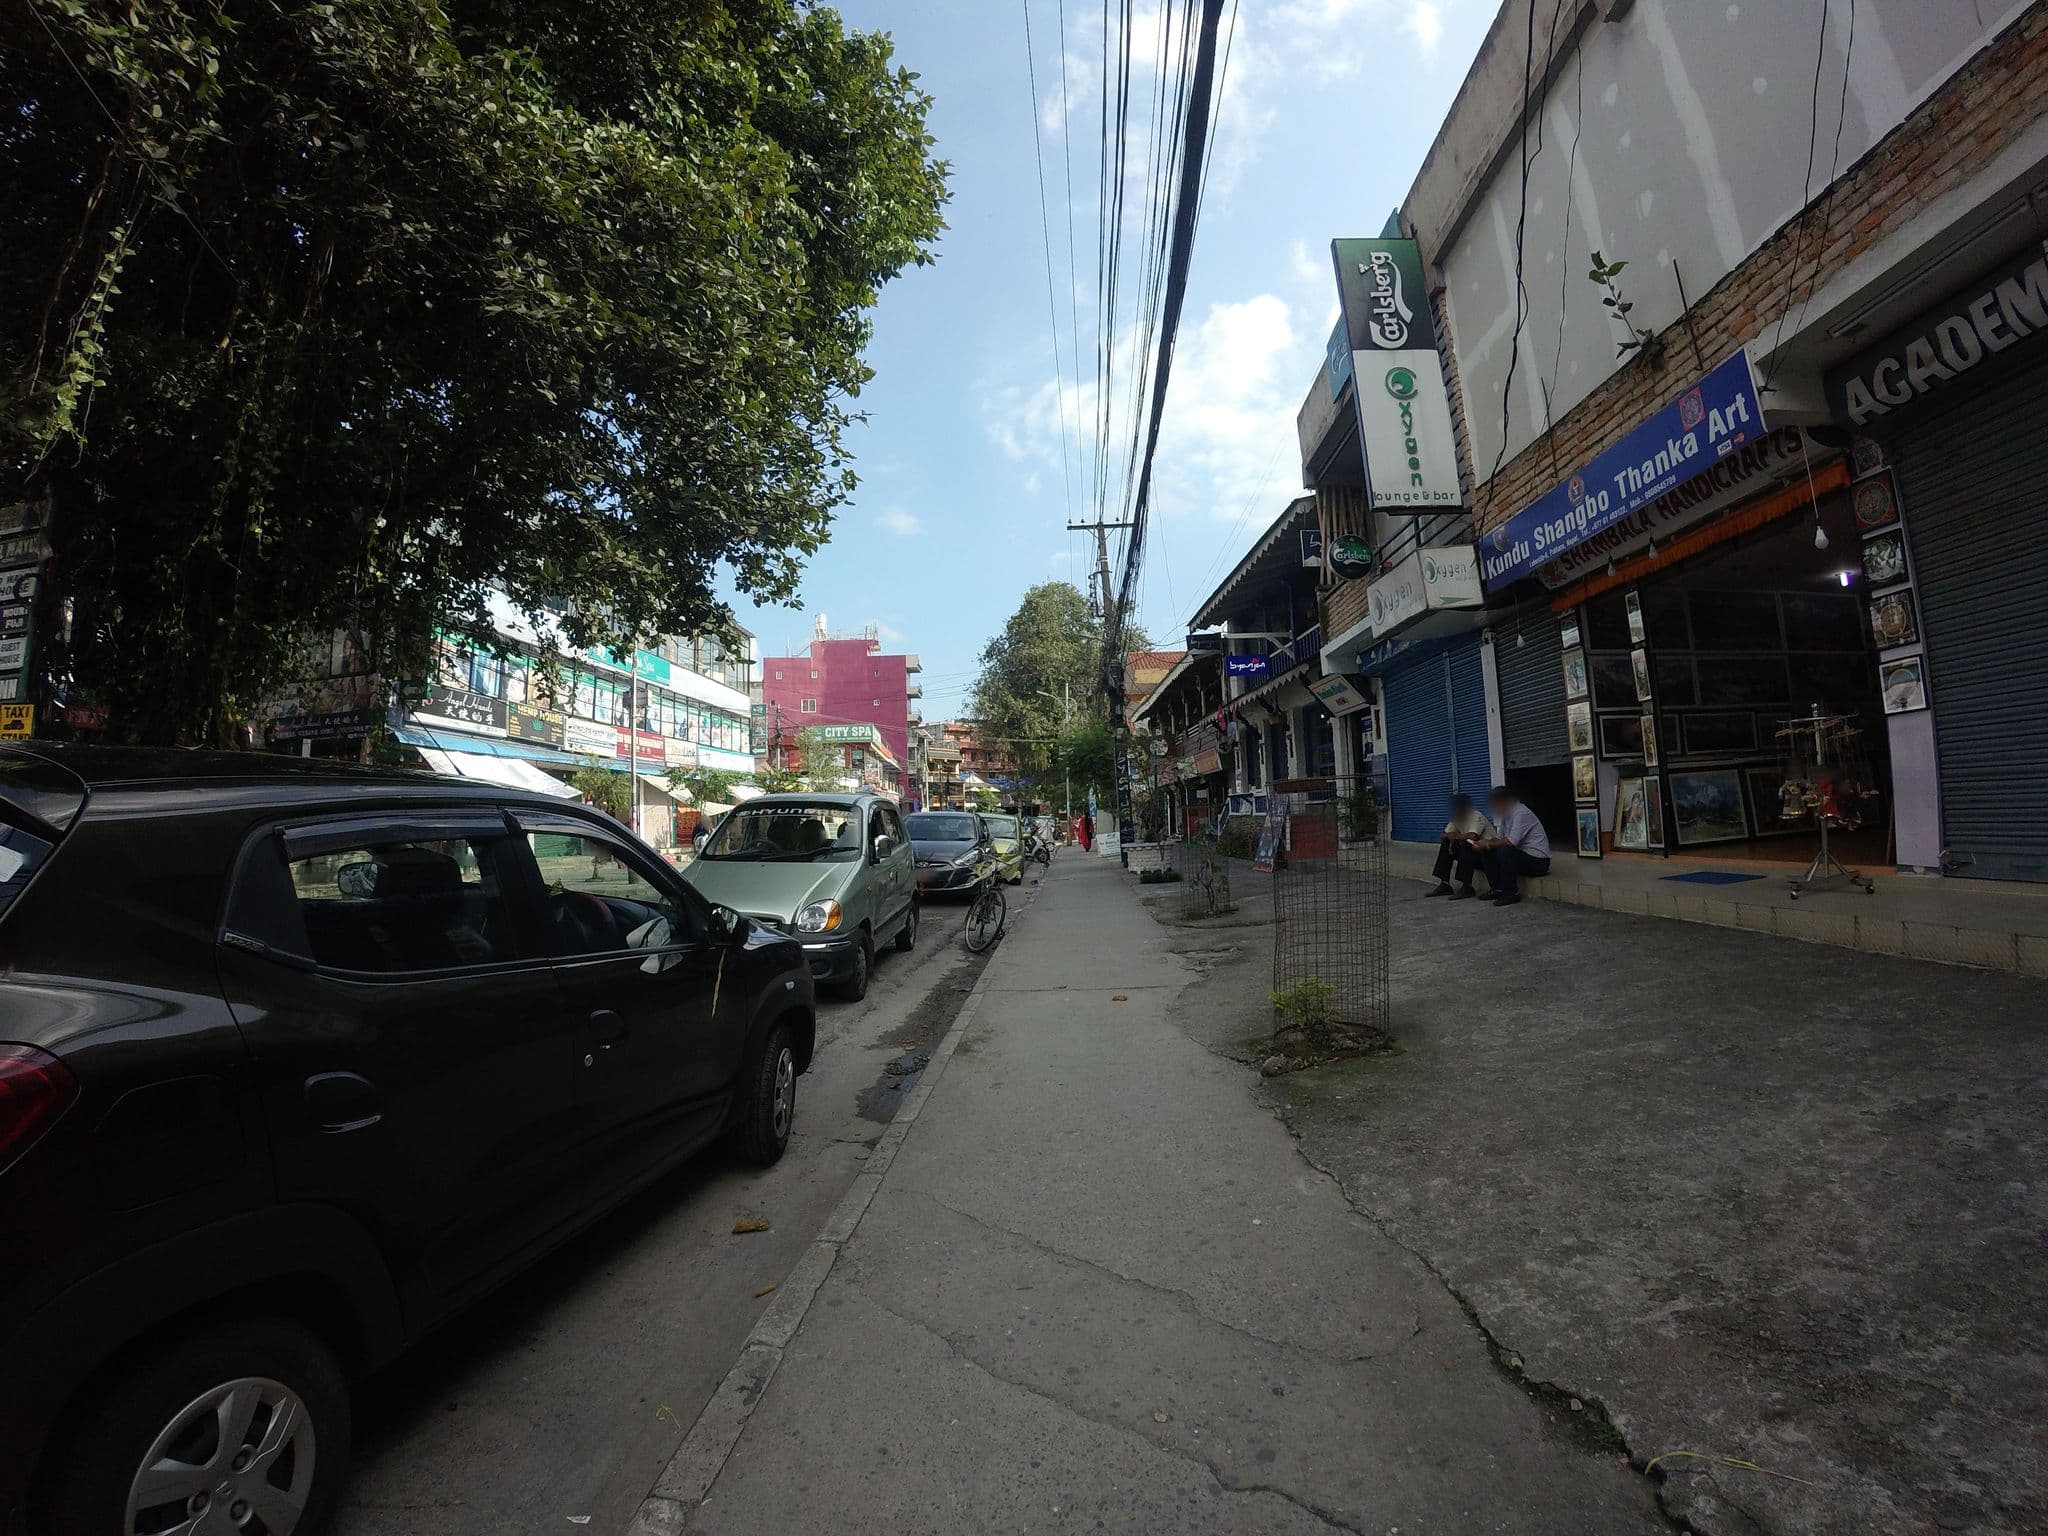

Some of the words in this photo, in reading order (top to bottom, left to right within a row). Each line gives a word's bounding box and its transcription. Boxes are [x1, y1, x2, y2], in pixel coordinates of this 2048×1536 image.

[1367, 251, 1414, 349] Carlsberg
[1845, 239, 2048, 427] ACADEM
[1384, 366, 1424, 487] Oxygen
[1433, 490, 1456, 501] bar
[1486, 540, 1530, 580] Kundu
[1533, 485, 1609, 550] Shangbo
[1614, 431, 1699, 499] Thanka
[1708, 392, 1750, 443] Art
[1333, 547, 1372, 564] Carlsberg
[1422, 556, 1467, 585] Oxygen
[3, 706, 30, 719] TAXI
[438, 691, 468, 709] Angel
[466, 697, 493, 713] Hands
[517, 705, 539, 718] HEMP
[539, 711, 563, 725] HOUSE
[825, 727, 849, 737] CITY
[851, 726, 872, 737] SPA
